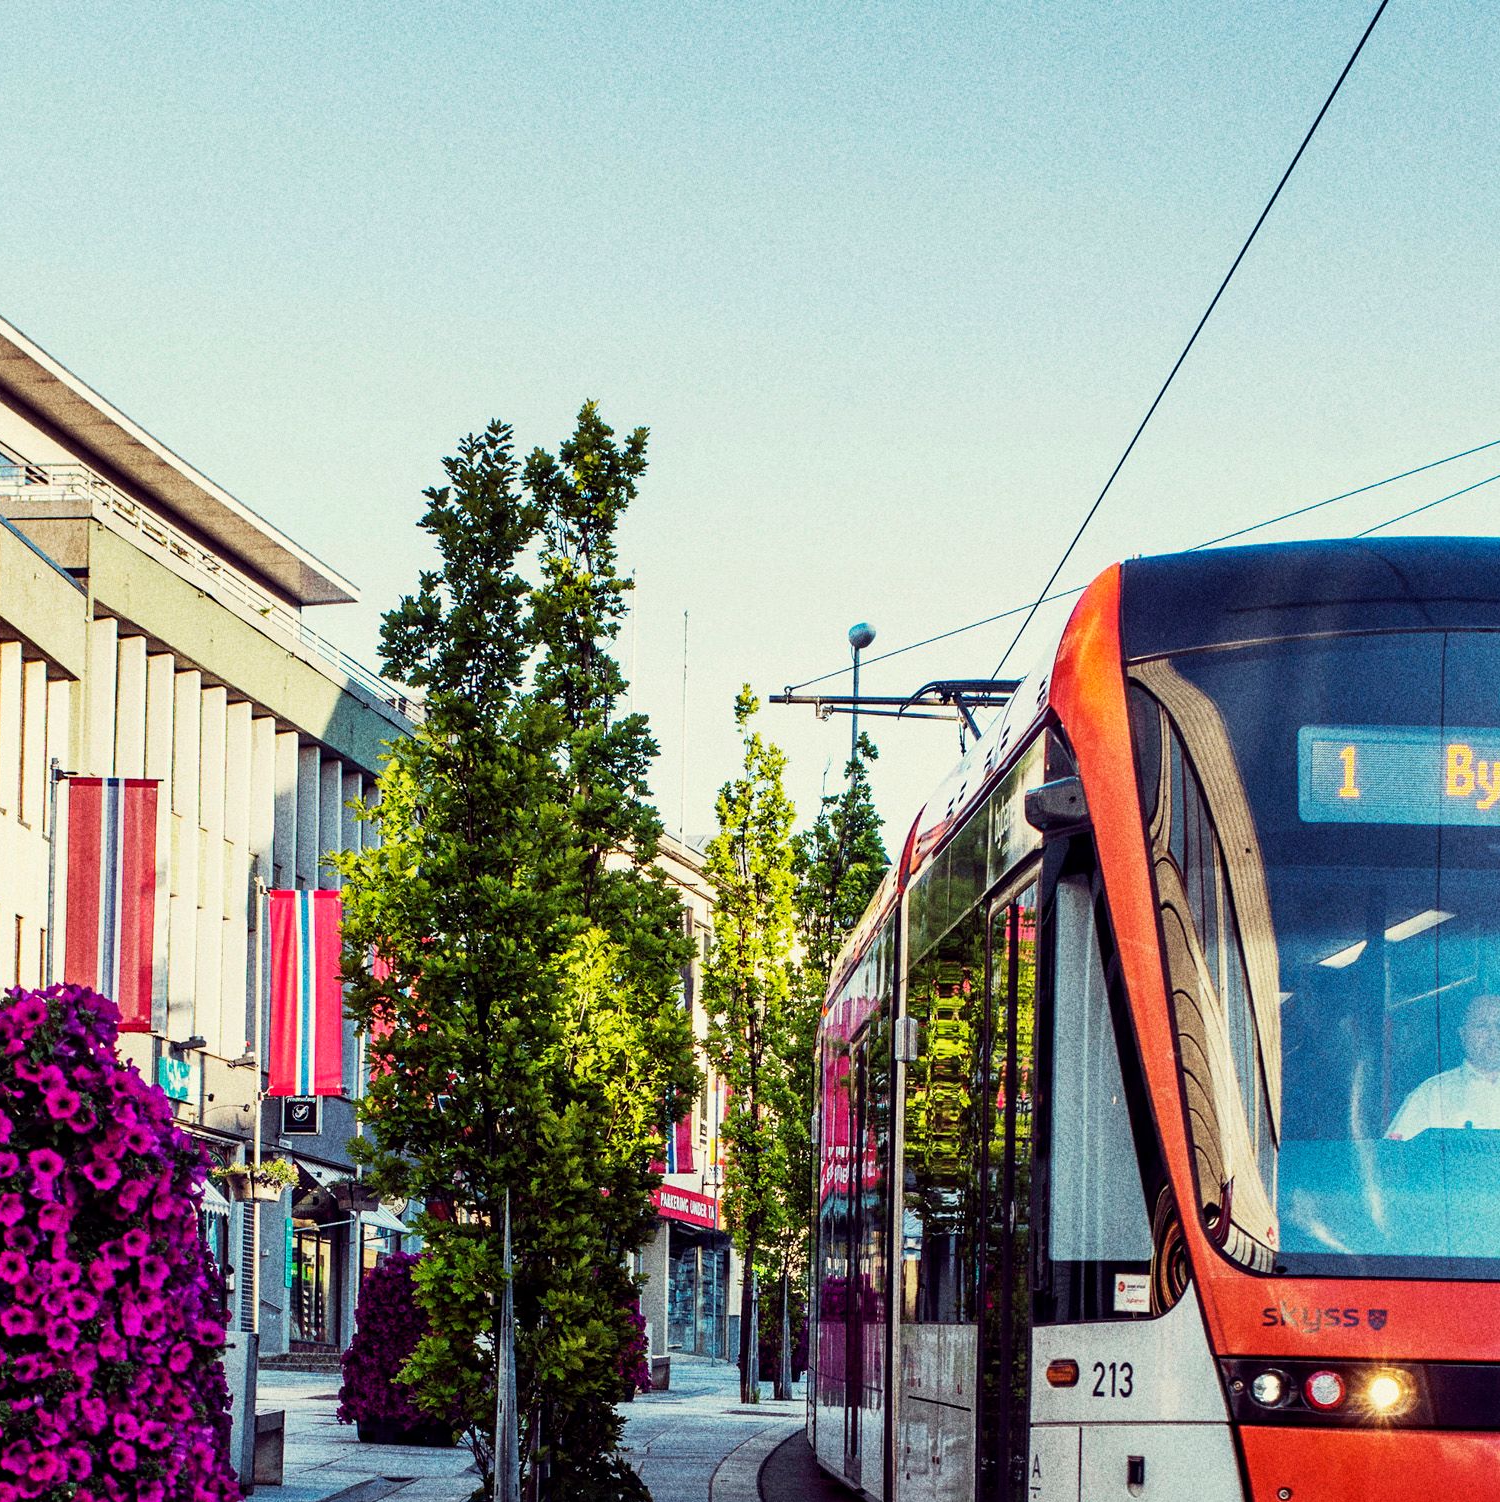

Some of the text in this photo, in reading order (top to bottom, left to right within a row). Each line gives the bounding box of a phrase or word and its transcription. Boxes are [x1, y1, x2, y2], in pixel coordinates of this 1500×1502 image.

[1339, 746, 1360, 798] 1
[661, 1192, 689, 1214] PARKERING
[690, 1199, 707, 1219] UNDER
[1261, 1300, 1360, 1334] skyss
[1092, 1361, 1134, 1399] 213
[1031, 1453, 1042, 1479] A
